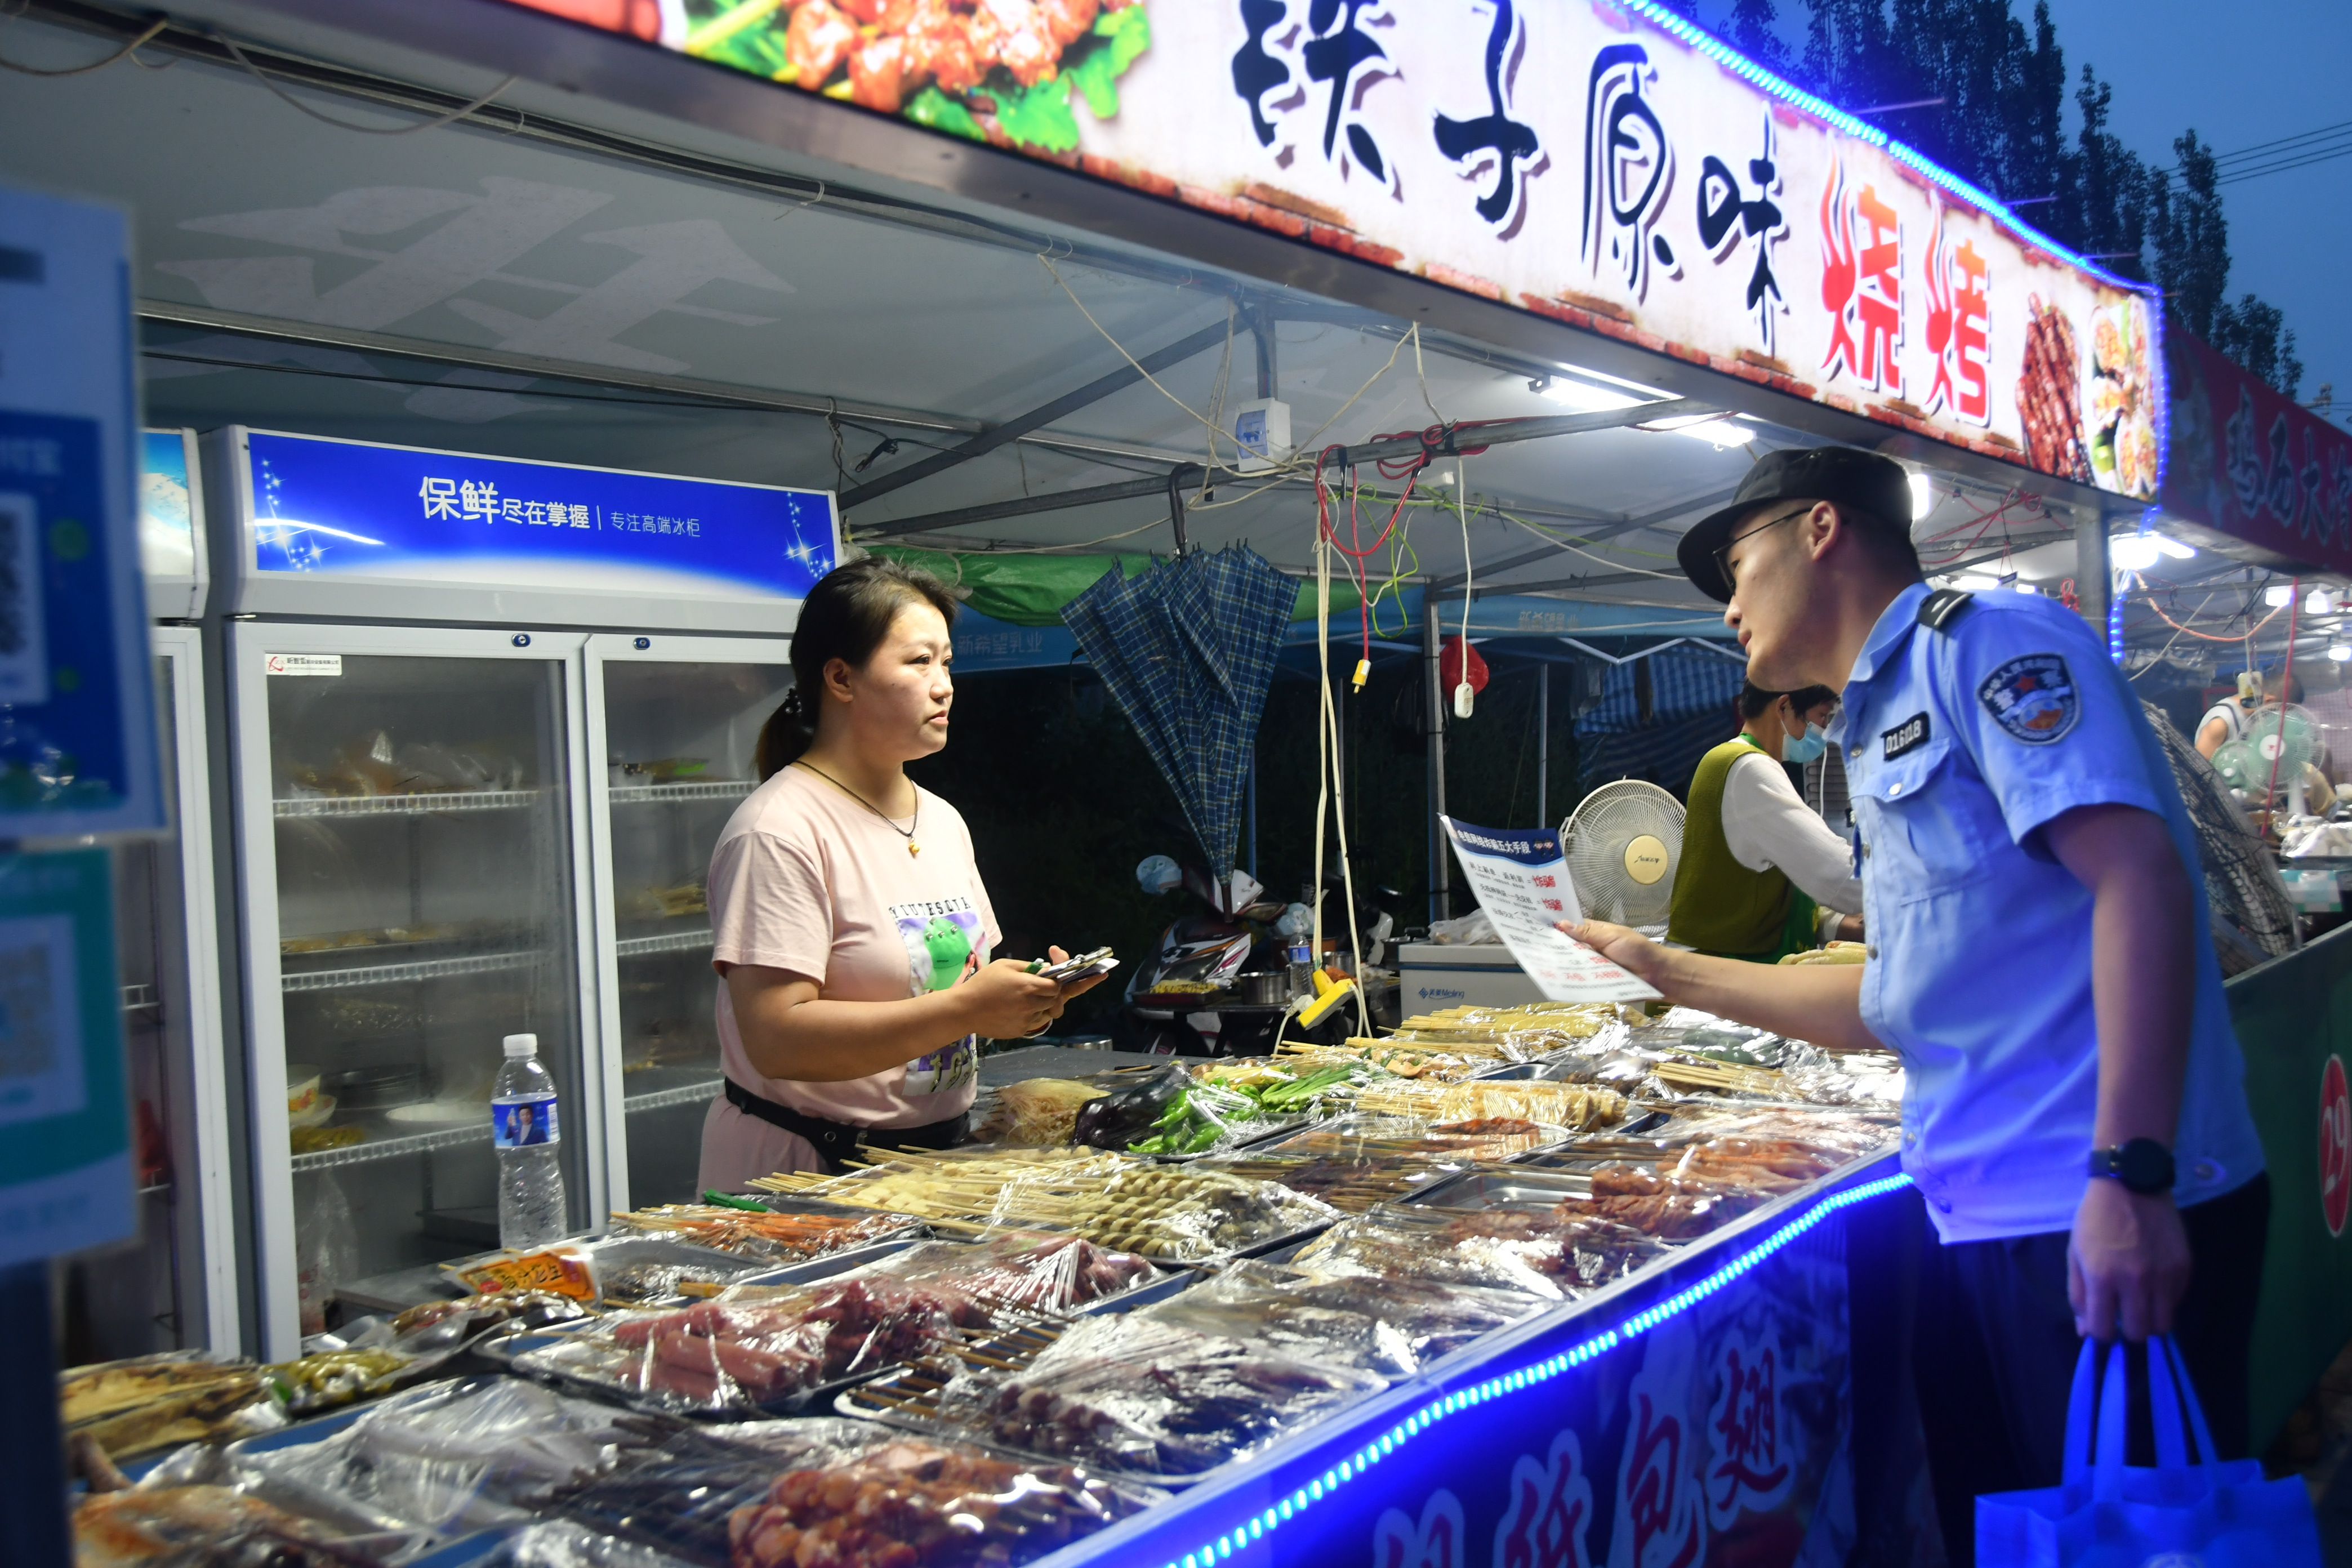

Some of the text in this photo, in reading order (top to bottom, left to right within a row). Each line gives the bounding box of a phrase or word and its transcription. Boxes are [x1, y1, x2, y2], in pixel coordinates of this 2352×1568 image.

[418, 476, 701, 538] 保鲜尽在掌握 专注高端冰柜
[957, 630, 1043, 655] 新希望乳业
[1456, 829, 1531, 854] 电信网络诈骗五大手段
[2322, 1095, 2350, 1196] 29
